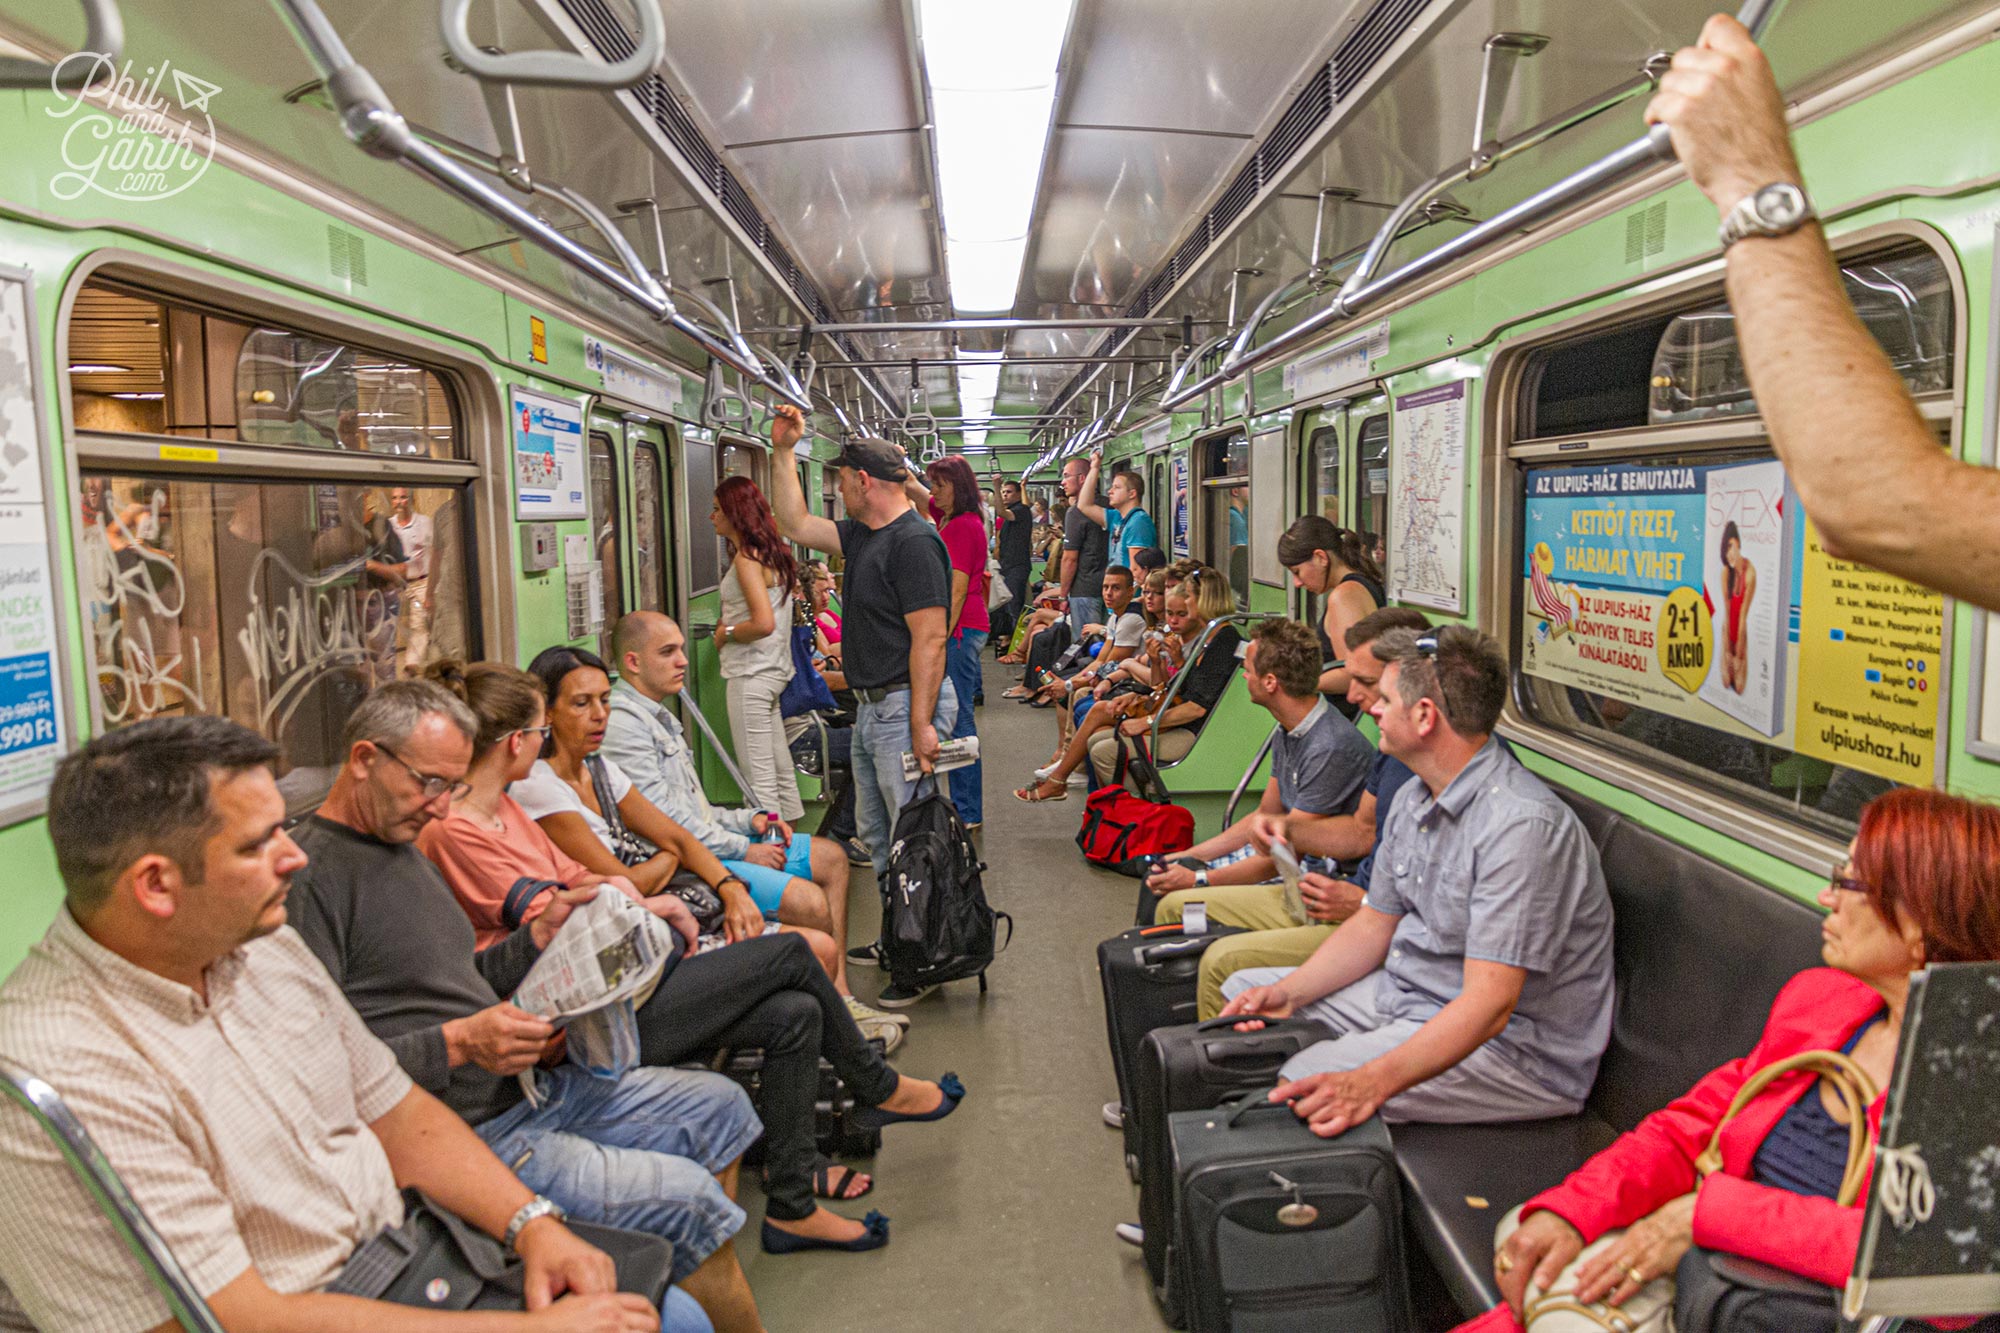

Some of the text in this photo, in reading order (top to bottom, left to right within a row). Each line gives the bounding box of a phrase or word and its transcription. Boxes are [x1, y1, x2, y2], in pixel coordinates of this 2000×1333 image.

[1536, 477, 1551, 493] AZ
[1553, 468, 1618, 494] ULPIUS-HÁZ
[1621, 468, 1696, 491] BEMUTATJA
[1709, 487, 1777, 528] SZEX
[1630, 510, 1678, 542] FIZET,
[1566, 539, 1685, 581] HÁRMAT VIHET
[1579, 597, 1651, 622] AZ ULPIUS-HÁZ
[1668, 601, 1699, 638] 2+1
[1893, 602, 1932, 617] Zsigmond
[1575, 616, 1654, 649] KÖNYVEK TELJES
[1579, 640, 1647, 672] KÍNÁLATÁBÓL!
[1668, 637, 1704, 668] AKCIÓ
[1893, 694, 1919, 707] Center
[36, 718, 54, 741] Ft
[1814, 701, 1933, 741] Keresse webshopunkat!
[1821, 725, 1921, 768] ulpiushaz.hu
